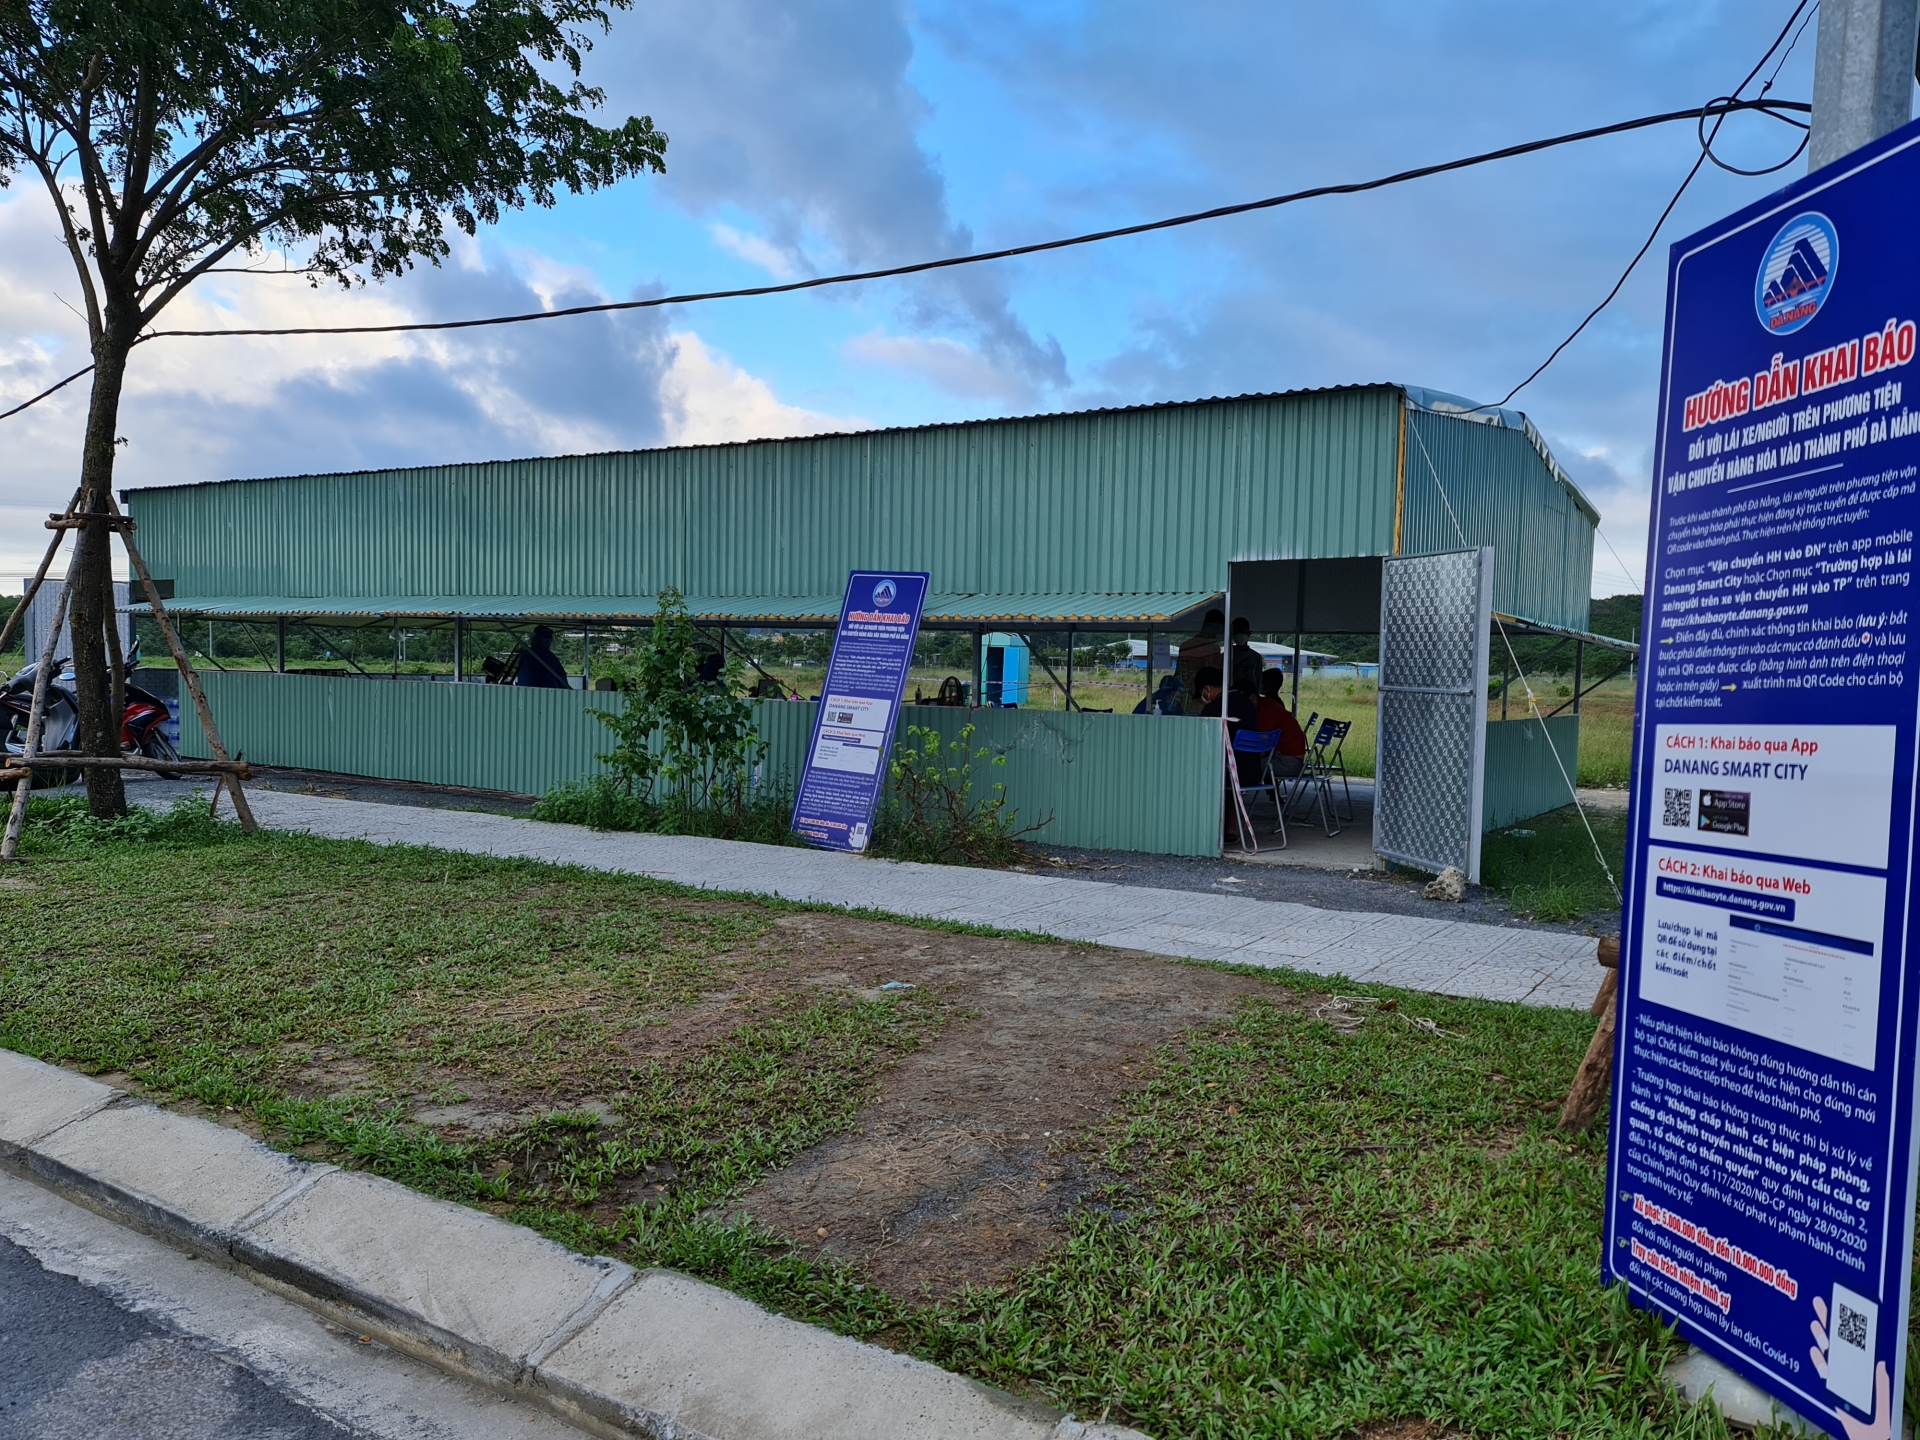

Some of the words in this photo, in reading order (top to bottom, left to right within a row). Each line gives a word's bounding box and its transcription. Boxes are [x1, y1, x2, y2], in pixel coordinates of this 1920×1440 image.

[1682, 376, 1751, 433] HƯỚNG
[1751, 352, 1800, 411] DẪN
[1800, 337, 1860, 396] KHAI
[1860, 317, 1917, 378] BÁO
[1687, 434, 1705, 462] ĐỐI
[1706, 432, 1723, 457] VỚI
[1723, 426, 1740, 452] LÁI
[1740, 411, 1790, 447] XE/NGƯỜI
[1792, 404, 1821, 433] TRÊN
[1822, 390, 1871, 425] PHƯƠNG
[1873, 380, 1902, 412] TIỆN
[1667, 470, 1686, 497] VẬN
[1686, 457, 1725, 490] CHUYỂN
[1725, 454, 1755, 480] HÀNG
[1755, 446, 1777, 472] HÓA
[1780, 440, 1801, 467] VÀO
[1803, 431, 1841, 461] THÀNH
[1842, 417, 1869, 451] PHỐ
[1869, 415, 1887, 444] ĐÀ
[1889, 406, 1920, 439] NẴN
[1662, 582, 1696, 596] Danang
[1696, 577, 1723, 591] Smart
[1723, 574, 1743, 588] City
[1743, 571, 1765, 585] hoặc
[1765, 567, 1791, 582] Chọn
[1792, 565, 1813, 579] mục
[1814, 558, 1858, 574] “Trường
[1860, 554, 1883, 571] hợp
[1884, 550, 1895, 565] là
[1896, 547, 1912, 563] lái
[1664, 566, 1686, 580] Chọn
[1686, 564, 1705, 577] mục
[1706, 558, 1729, 574] “Vận
[1729, 551, 1764, 569] chuyển
[1766, 549, 1782, 563] HH
[1783, 547, 1802, 561] vào
[1804, 541, 1827, 558] ĐN”
[1828, 539, 1849, 554] trên
[1851, 537, 1872, 552] app
[1874, 528, 1913, 547] mobile
[1660, 603, 1809, 629] https://khaibaoyte.danang.gov.vn
[1661, 596, 1699, 613] xe/người
[1700, 594, 1720, 607] trên
[1720, 594, 1733, 605] xe
[1734, 590, 1752, 605] vận
[1753, 583, 1789, 602] chuyển
[1791, 582, 1808, 596] HH
[1810, 580, 1830, 594] vào
[1832, 575, 1853, 591] TP”
[1855, 573, 1877, 589] trên
[1880, 572, 1910, 587] trang
[1675, 629, 1695, 643] Điền
[1694, 628, 1711, 643] đầy
[1710, 626, 1724, 640] đủ,
[1724, 624, 1750, 639] chính
[1750, 623, 1766, 636] xác
[1766, 621, 1796, 636] thông
[1796, 620, 1810, 633] tin
[1811, 617, 1832, 632] khai
[1833, 615, 1854, 630] báo
[1855, 613, 1877, 629] (lưu
[1876, 611, 1888, 629] ý:
[1889, 609, 1908, 625] bắt
[1664, 758, 1719, 776] DANANG
[1721, 760, 1772, 778] SMART
[1773, 762, 1808, 781] CITY
[1666, 733, 1696, 749] CÁCH
[1698, 736, 1708, 749] 1:
[1710, 735, 1736, 750] Khai
[1738, 736, 1761, 751] báo
[1763, 740, 1788, 755] qua
[1790, 737, 1818, 756] App
[1711, 819, 1733, 832] Google
[1732, 822, 1746, 833] Play
[1713, 798, 1728, 809] App
[1727, 798, 1746, 810] Store
[1658, 856, 1688, 874] CÁCH
[1689, 862, 1700, 876] 2:
[1702, 864, 1728, 881] Khai
[1730, 867, 1753, 885] báo
[1755, 876, 1780, 891] qua
[1782, 876, 1811, 895] Web
[1662, 881, 1786, 913] https://khaibaoyte.danang.gov.vn
[1631, 1081, 1651, 1099] hành
[1653, 1092, 1661, 1103] vi
[1664, 1094, 1696, 1120] “Không
[1698, 1110, 1722, 1130] chấp
[1724, 1119, 1749, 1140] hành
[1752, 1133, 1769, 1149] các
[1772, 1138, 1795, 1160] biện
[1798, 1152, 1827, 1175] pháp
[1830, 1165, 1870, 1193] phòng,
[1628, 1130, 1646, 1147] điều
[1647, 1138, 1657, 1152] 14
[1658, 1143, 1678, 1164] Nghị
[1678, 1154, 1698, 1172] định
[1699, 1164, 1710, 1177] số
[1712, 1168, 1786, 1212] 117/2020/NĐ-CP
[1787, 1206, 1812, 1228] ngày
[1814, 1216, 1867, 1252] 28/9/2020
[1631, 1219, 1644, 1235] đối
[1644, 1228, 1656, 1242] với
[1656, 1235, 1671, 1250] mỗi
[1671, 1244, 1695, 1264] người
[1695, 1256, 1703, 1268] vi
[1703, 1261, 1727, 1282] phạm
[1632, 1192, 1646, 1217] Xử
[1643, 1199, 1662, 1225] phạt:
[1660, 1207, 1697, 1243] 5.000.000
[1694, 1226, 1716, 1256] đồng
[1713, 1236, 1732, 1263] đến
[1729, 1244, 1776, 1286] 10.000.000
[1773, 1268, 1798, 1301] đồng
[1630, 1236, 1647, 1264] Truy
[1645, 1247, 1661, 1271] cứu
[1658, 1253, 1679, 1282] trách
[1676, 1266, 1703, 1296] nhiệm
[1700, 1277, 1720, 1306] hình
[1718, 1290, 1732, 1315] sự
[1628, 1260, 1641, 1275] đối
[1640, 1268, 1652, 1282] với
[1663, 1282, 1688, 1307] trường
[1687, 1294, 1703, 1315] hợp
[1703, 1304, 1718, 1323] làm
[1718, 1313, 1730, 1332] lây
[1730, 1320, 1743, 1339] lan
[1743, 1330, 1762, 1350] dịch
[1762, 1341, 1800, 1373] Covid-19
